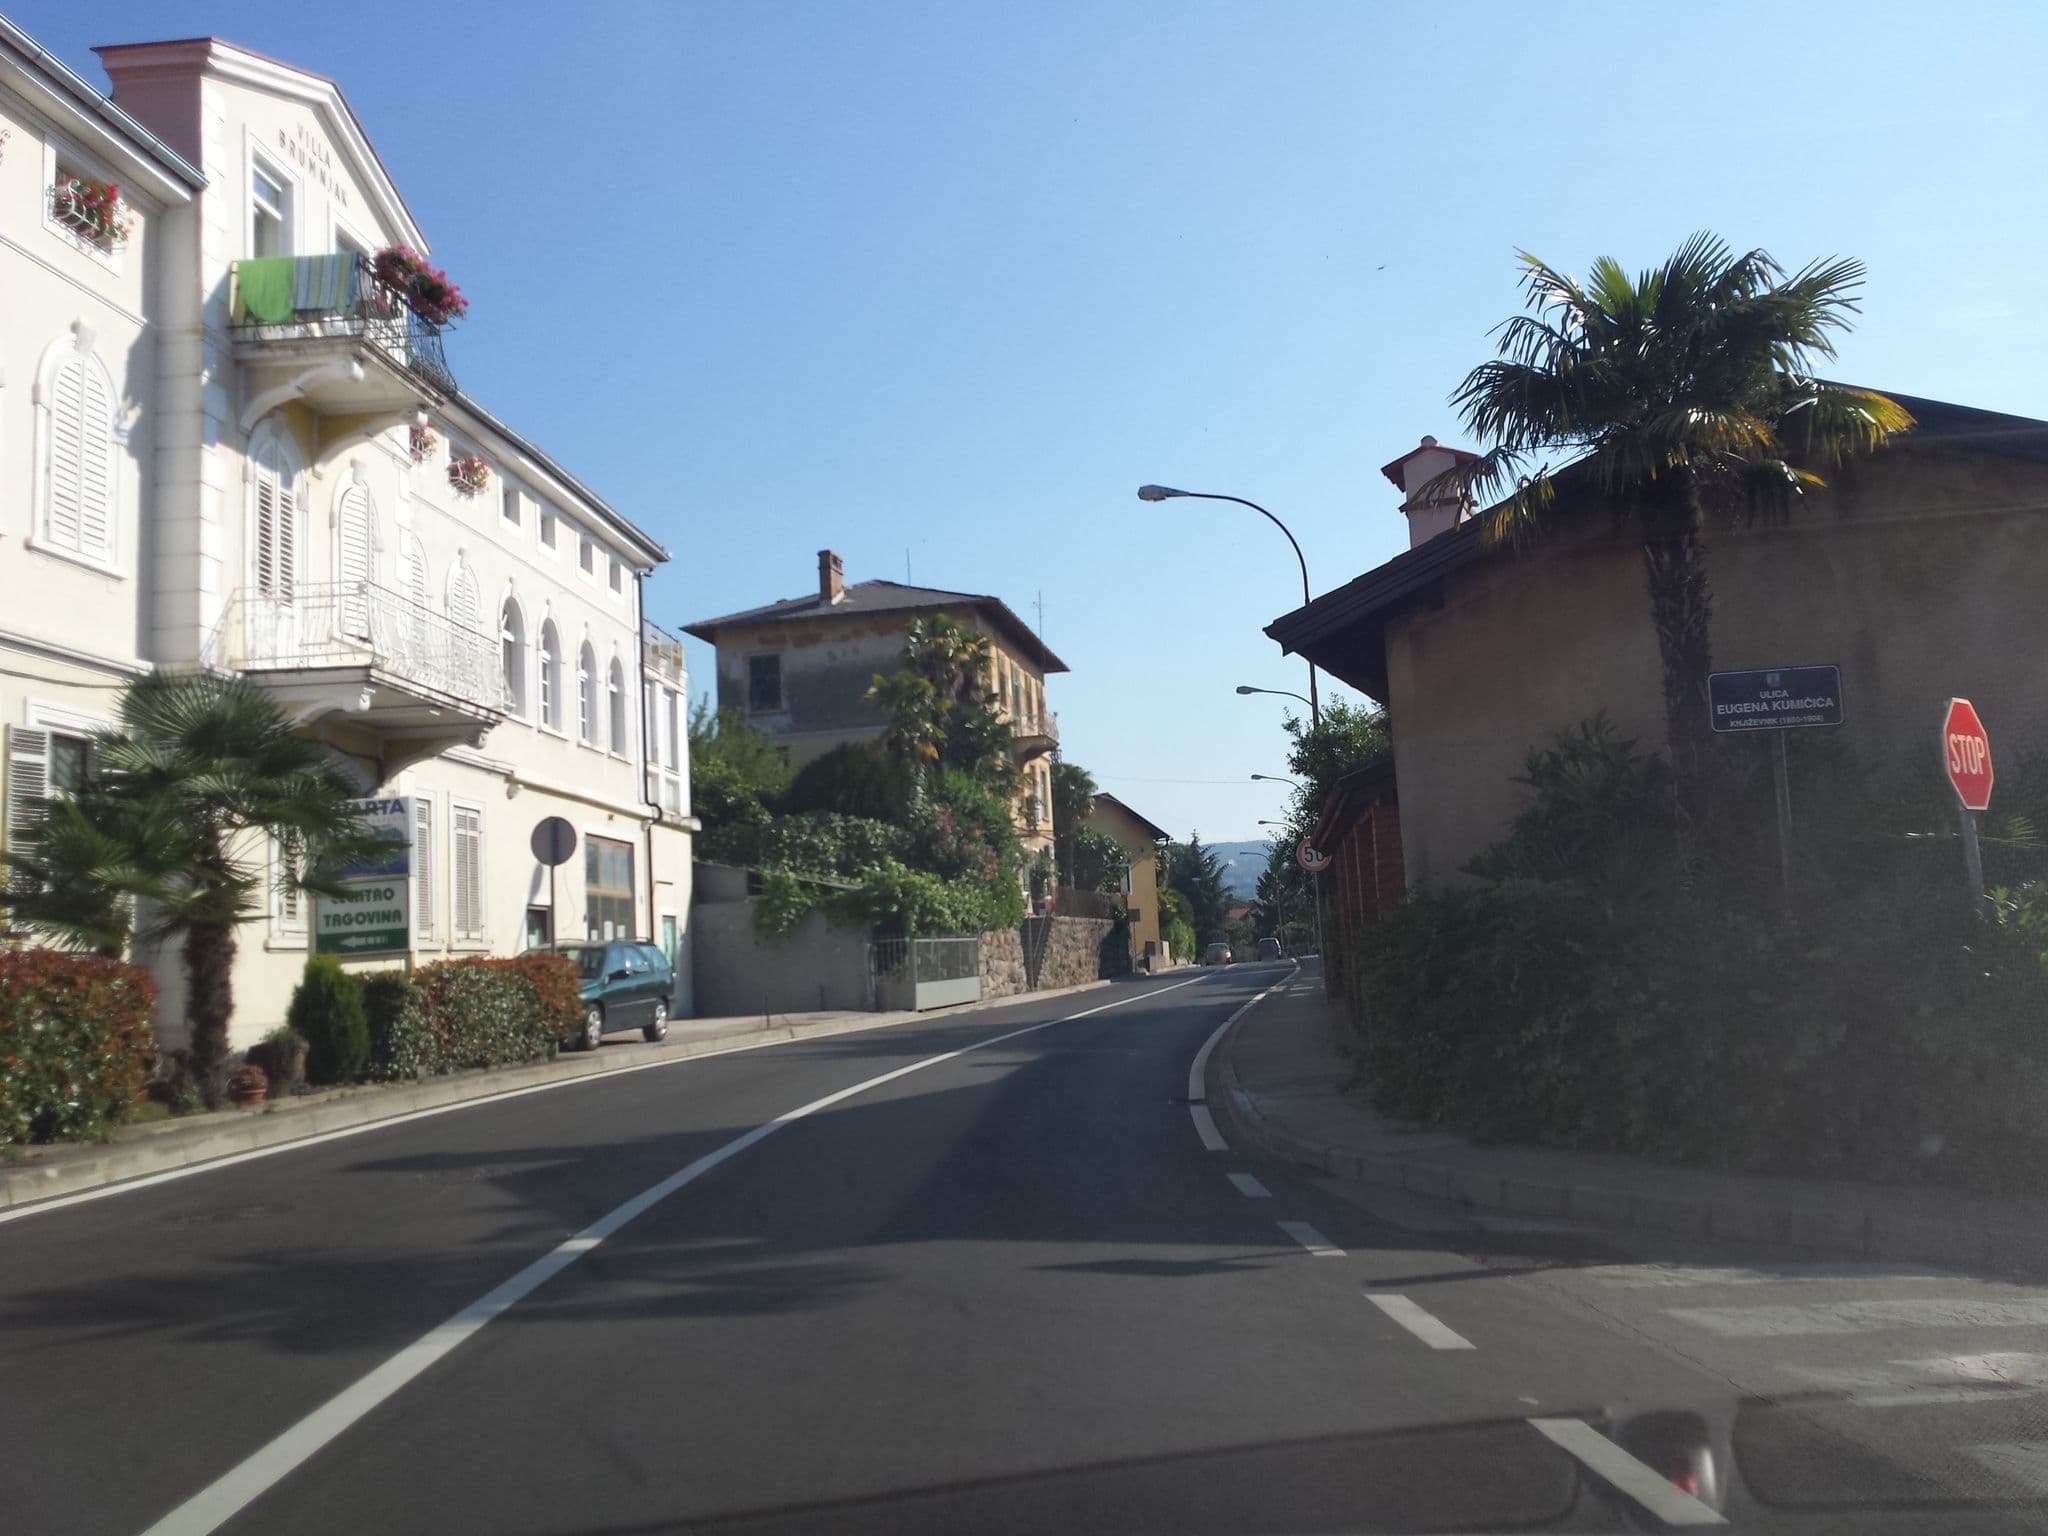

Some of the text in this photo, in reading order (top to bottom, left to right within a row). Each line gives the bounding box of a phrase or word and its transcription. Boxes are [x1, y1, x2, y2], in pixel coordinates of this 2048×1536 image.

[297, 122, 331, 169] VILLA
[1759, 689, 1789, 699] ULICA
[1716, 703, 1769, 715] EUGENA
[1949, 733, 1985, 775] STOP
[350, 799, 405, 817] ARTA
